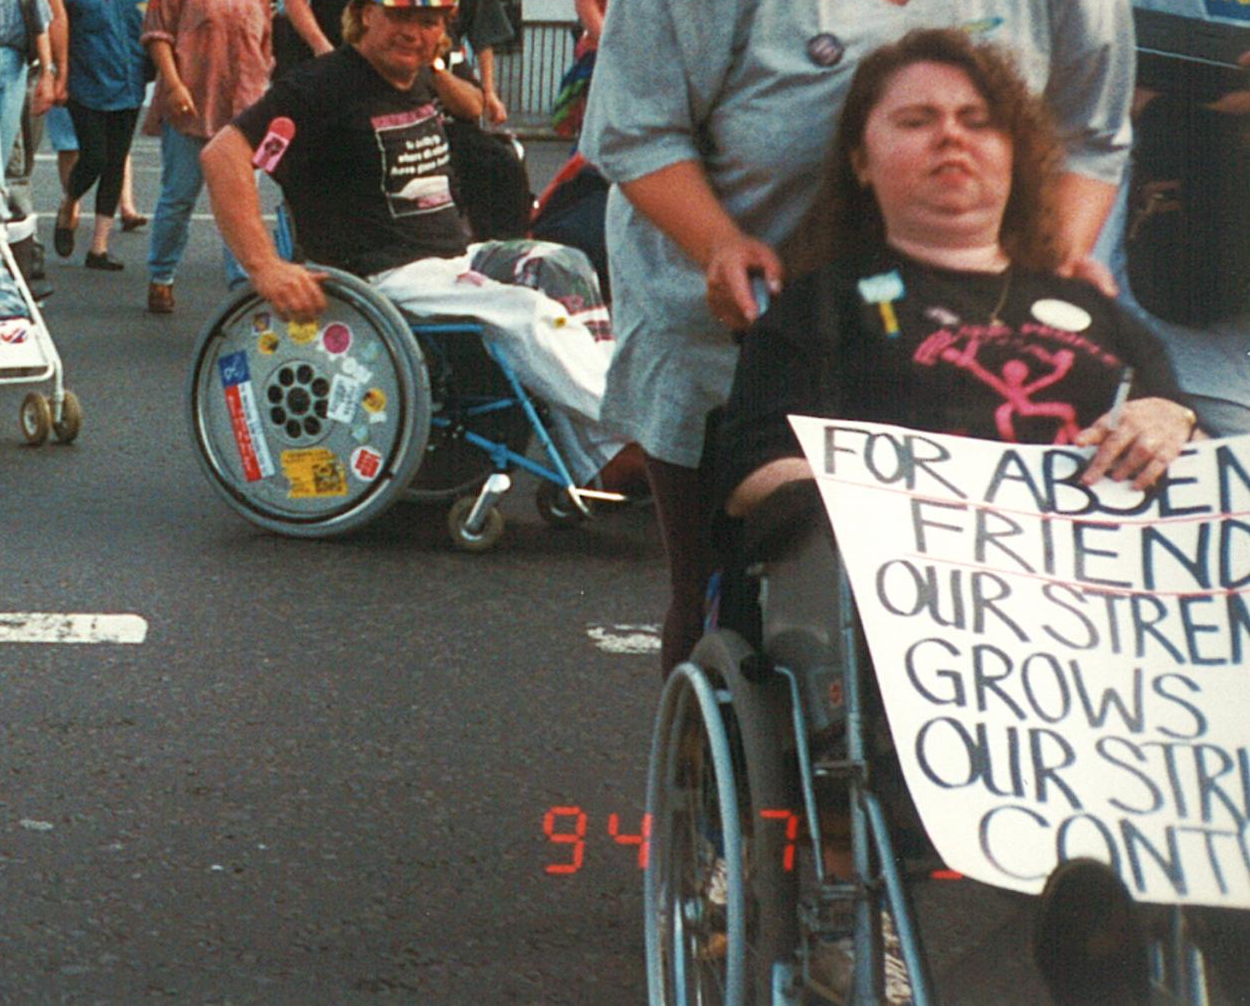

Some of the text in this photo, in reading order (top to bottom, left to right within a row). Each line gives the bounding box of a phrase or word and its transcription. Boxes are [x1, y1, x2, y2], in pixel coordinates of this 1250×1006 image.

[824, 425, 969, 500] FOR
[909, 496, 1250, 591] FRIEND
[875, 559, 1031, 643] OUR
[904, 637, 1210, 740] GROWS
[914, 715, 1083, 811] OUR
